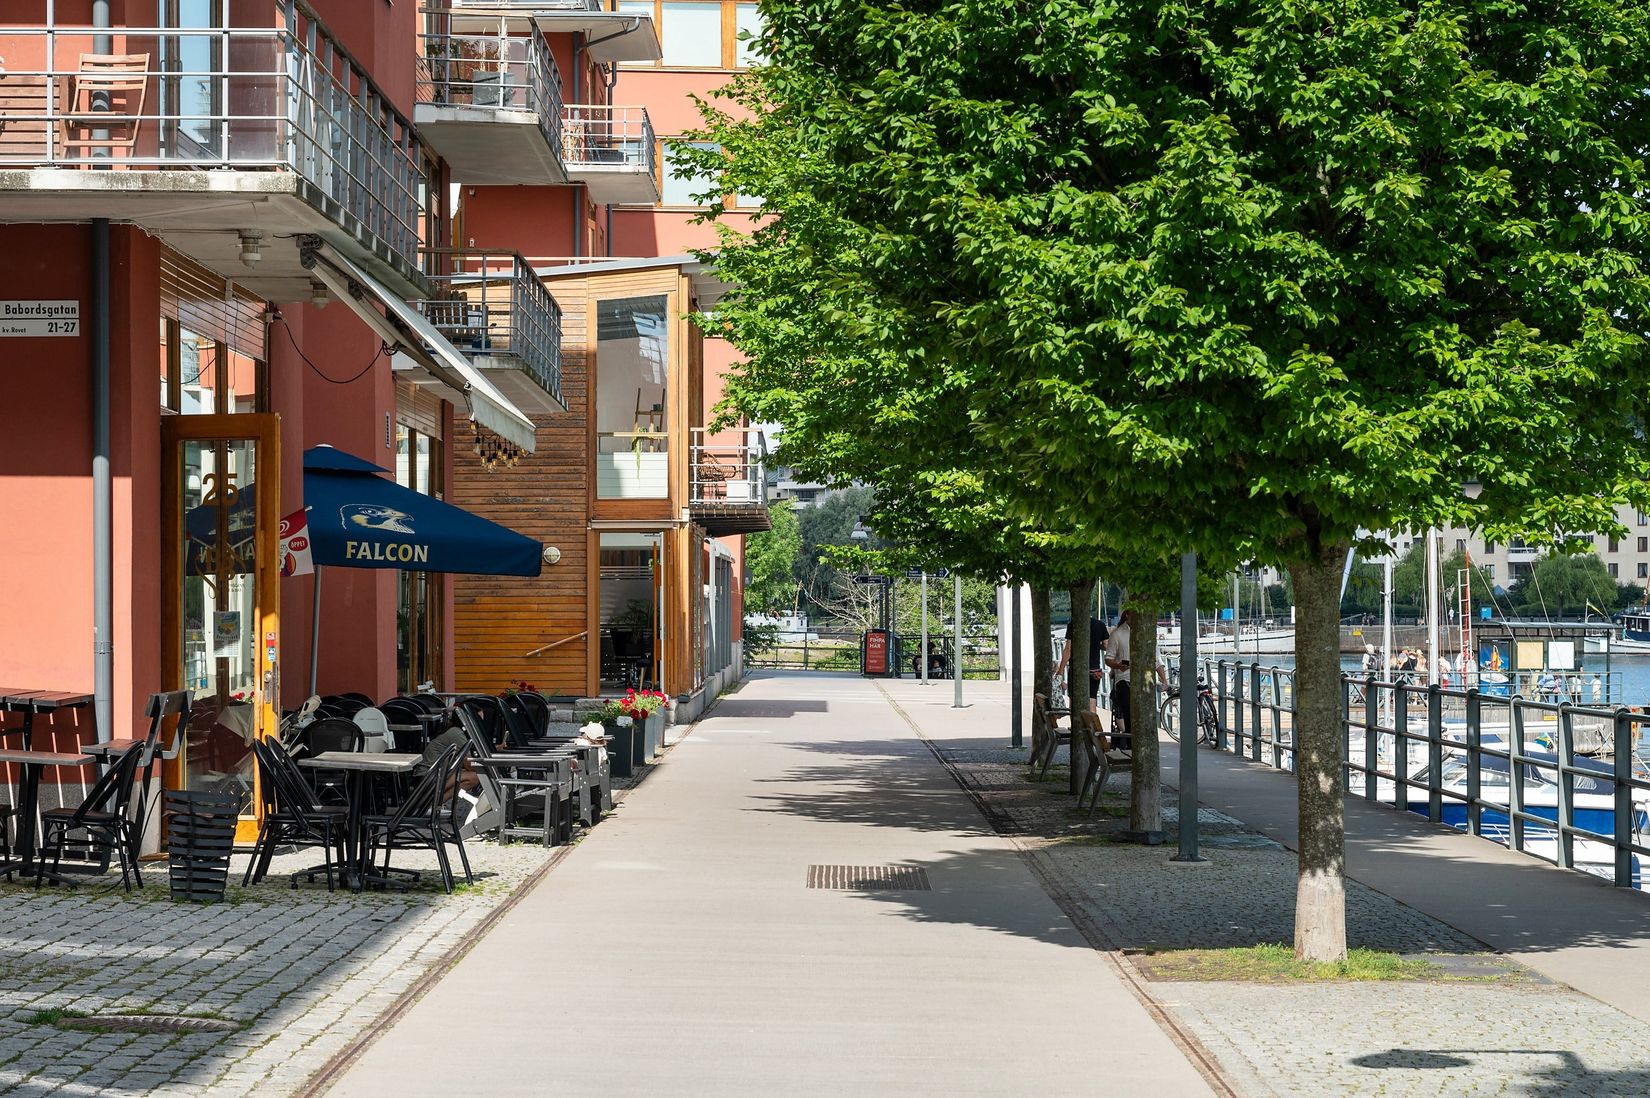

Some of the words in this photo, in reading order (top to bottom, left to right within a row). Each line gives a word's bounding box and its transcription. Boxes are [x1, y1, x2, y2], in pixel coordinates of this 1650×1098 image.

[5, 303, 77, 317] Babordsgatan
[47, 322, 76, 333] 21-27
[203, 473, 239, 506] 25
[345, 541, 429, 563] FALCON
